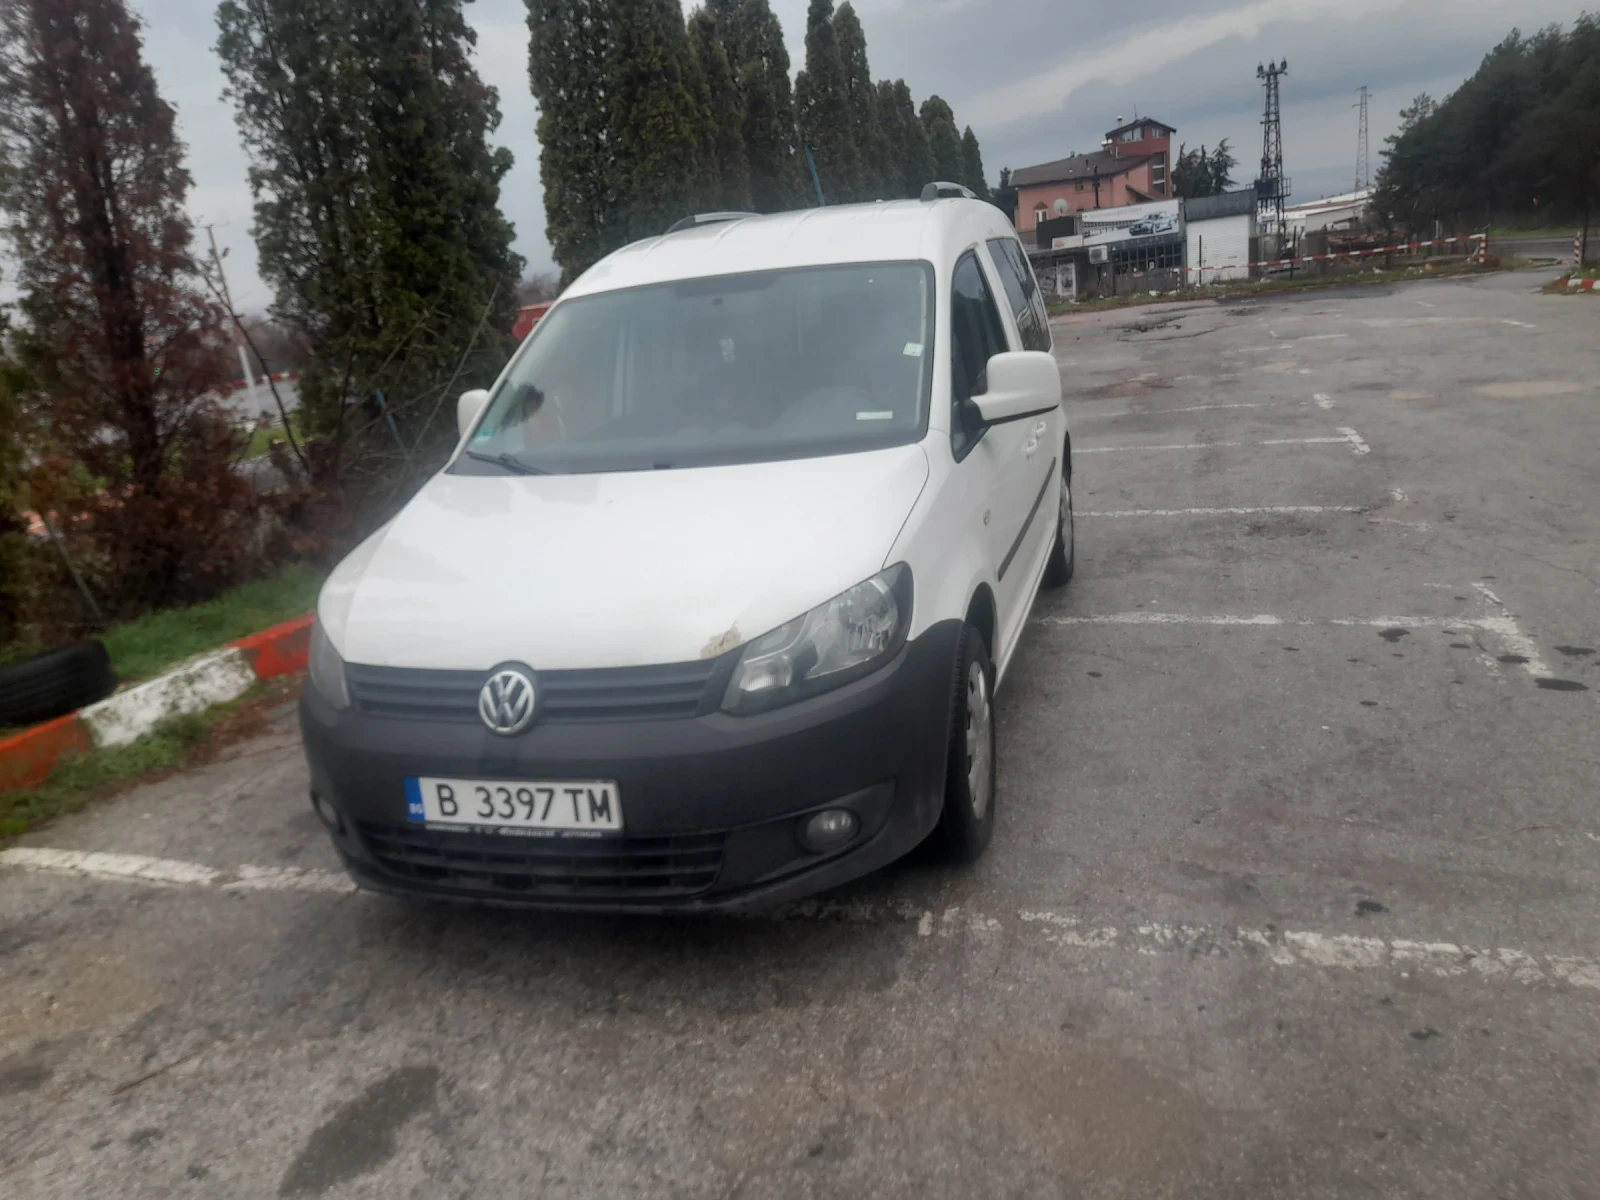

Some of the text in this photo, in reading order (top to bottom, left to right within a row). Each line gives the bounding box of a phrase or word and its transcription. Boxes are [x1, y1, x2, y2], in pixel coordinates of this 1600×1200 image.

[437, 784, 611, 822] B 3397 TM
